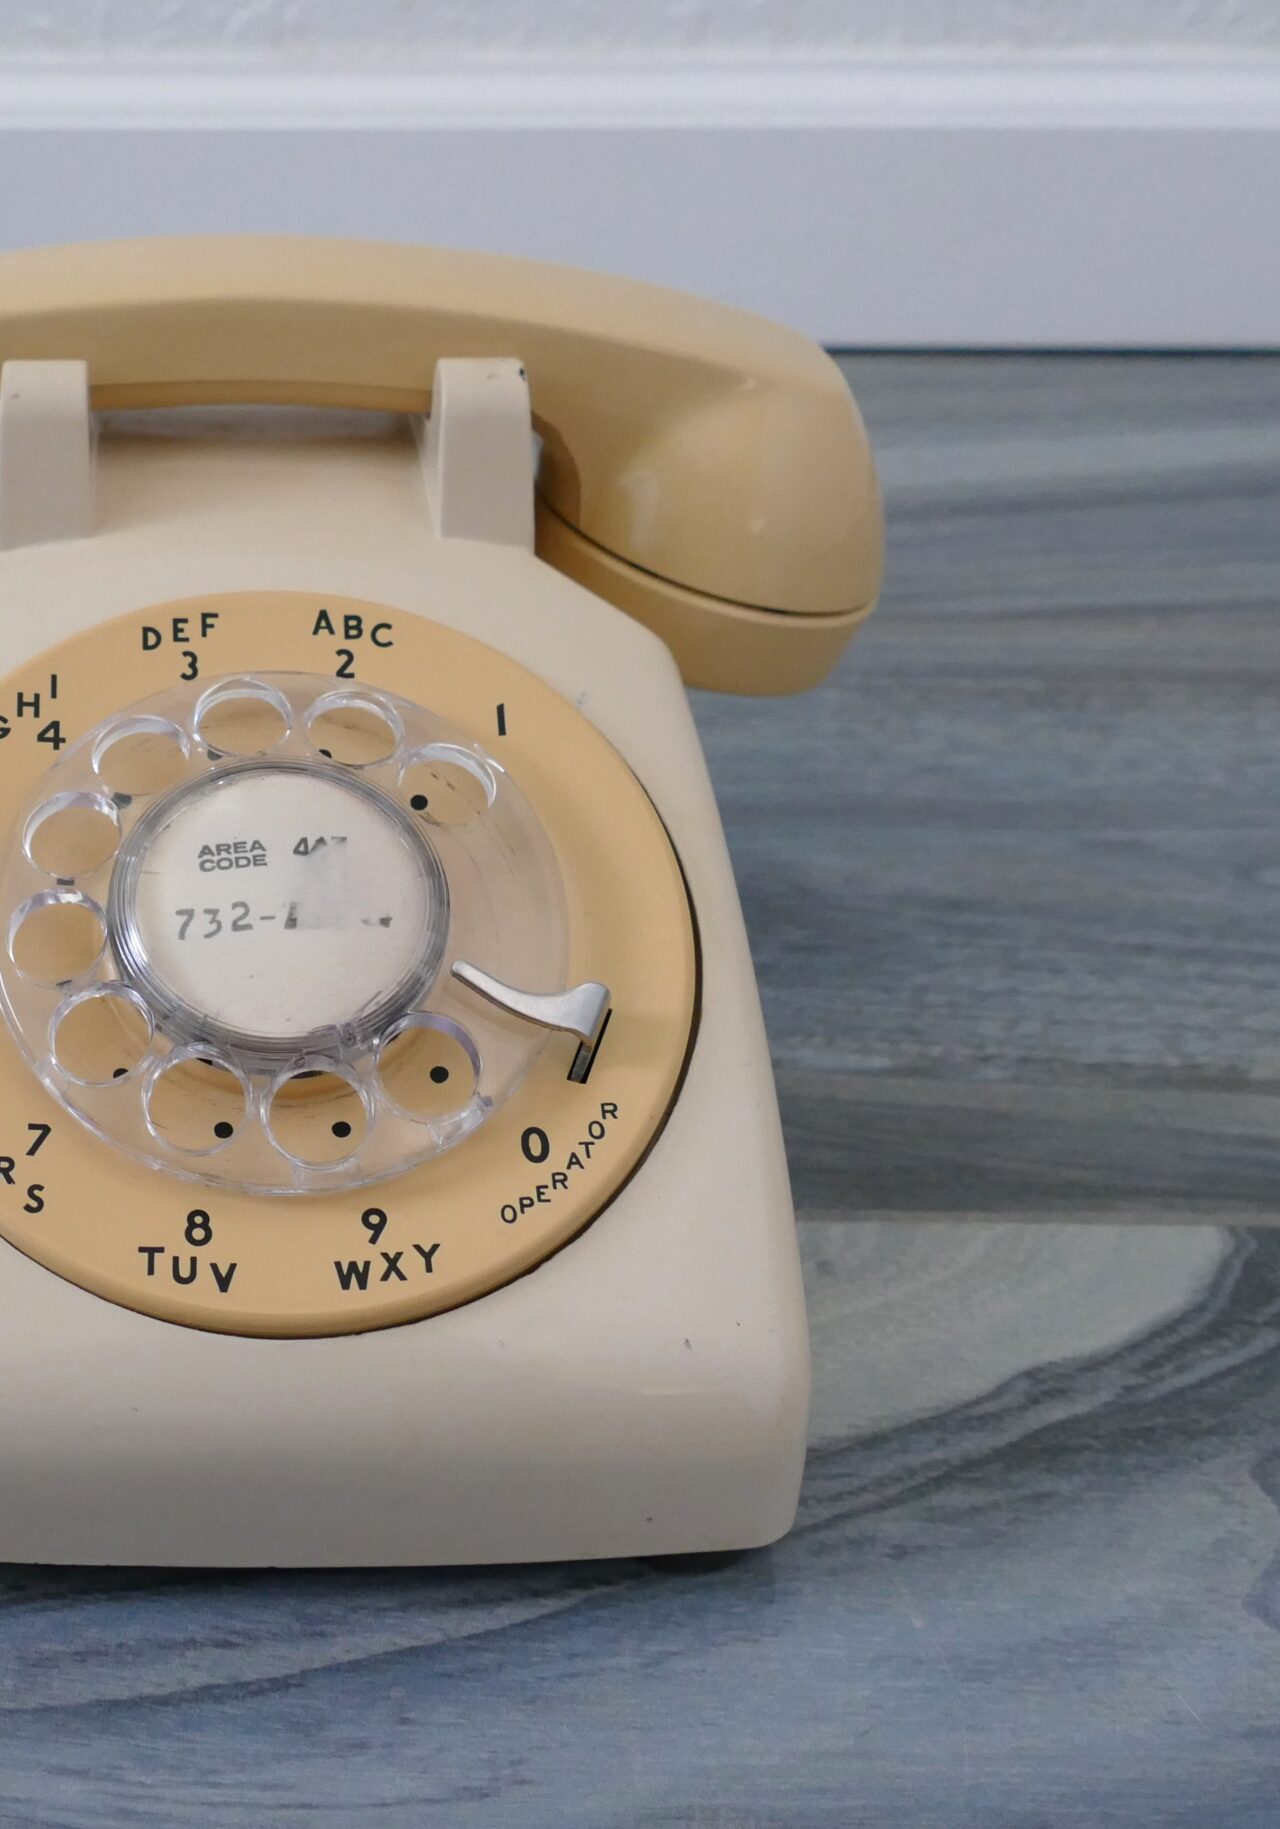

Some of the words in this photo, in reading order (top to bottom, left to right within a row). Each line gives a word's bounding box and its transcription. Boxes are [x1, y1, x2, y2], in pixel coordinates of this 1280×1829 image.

[141, 612, 219, 651] DEF
[312, 609, 394, 648] ABC
[180, 650, 199, 681] 3
[335, 648, 355, 679] 2
[36, 720, 67, 751] 4
[197, 839, 267, 859] AREA
[199, 854, 268, 873] CODE
[25, 1122, 52, 1157] 7
[500, 1102, 618, 1224] OPERATOR
[184, 1208, 213, 1247] 8
[360, 1207, 388, 1246] 9
[137, 1246, 238, 1294] TUV
[333, 1243, 441, 1291] WXY
